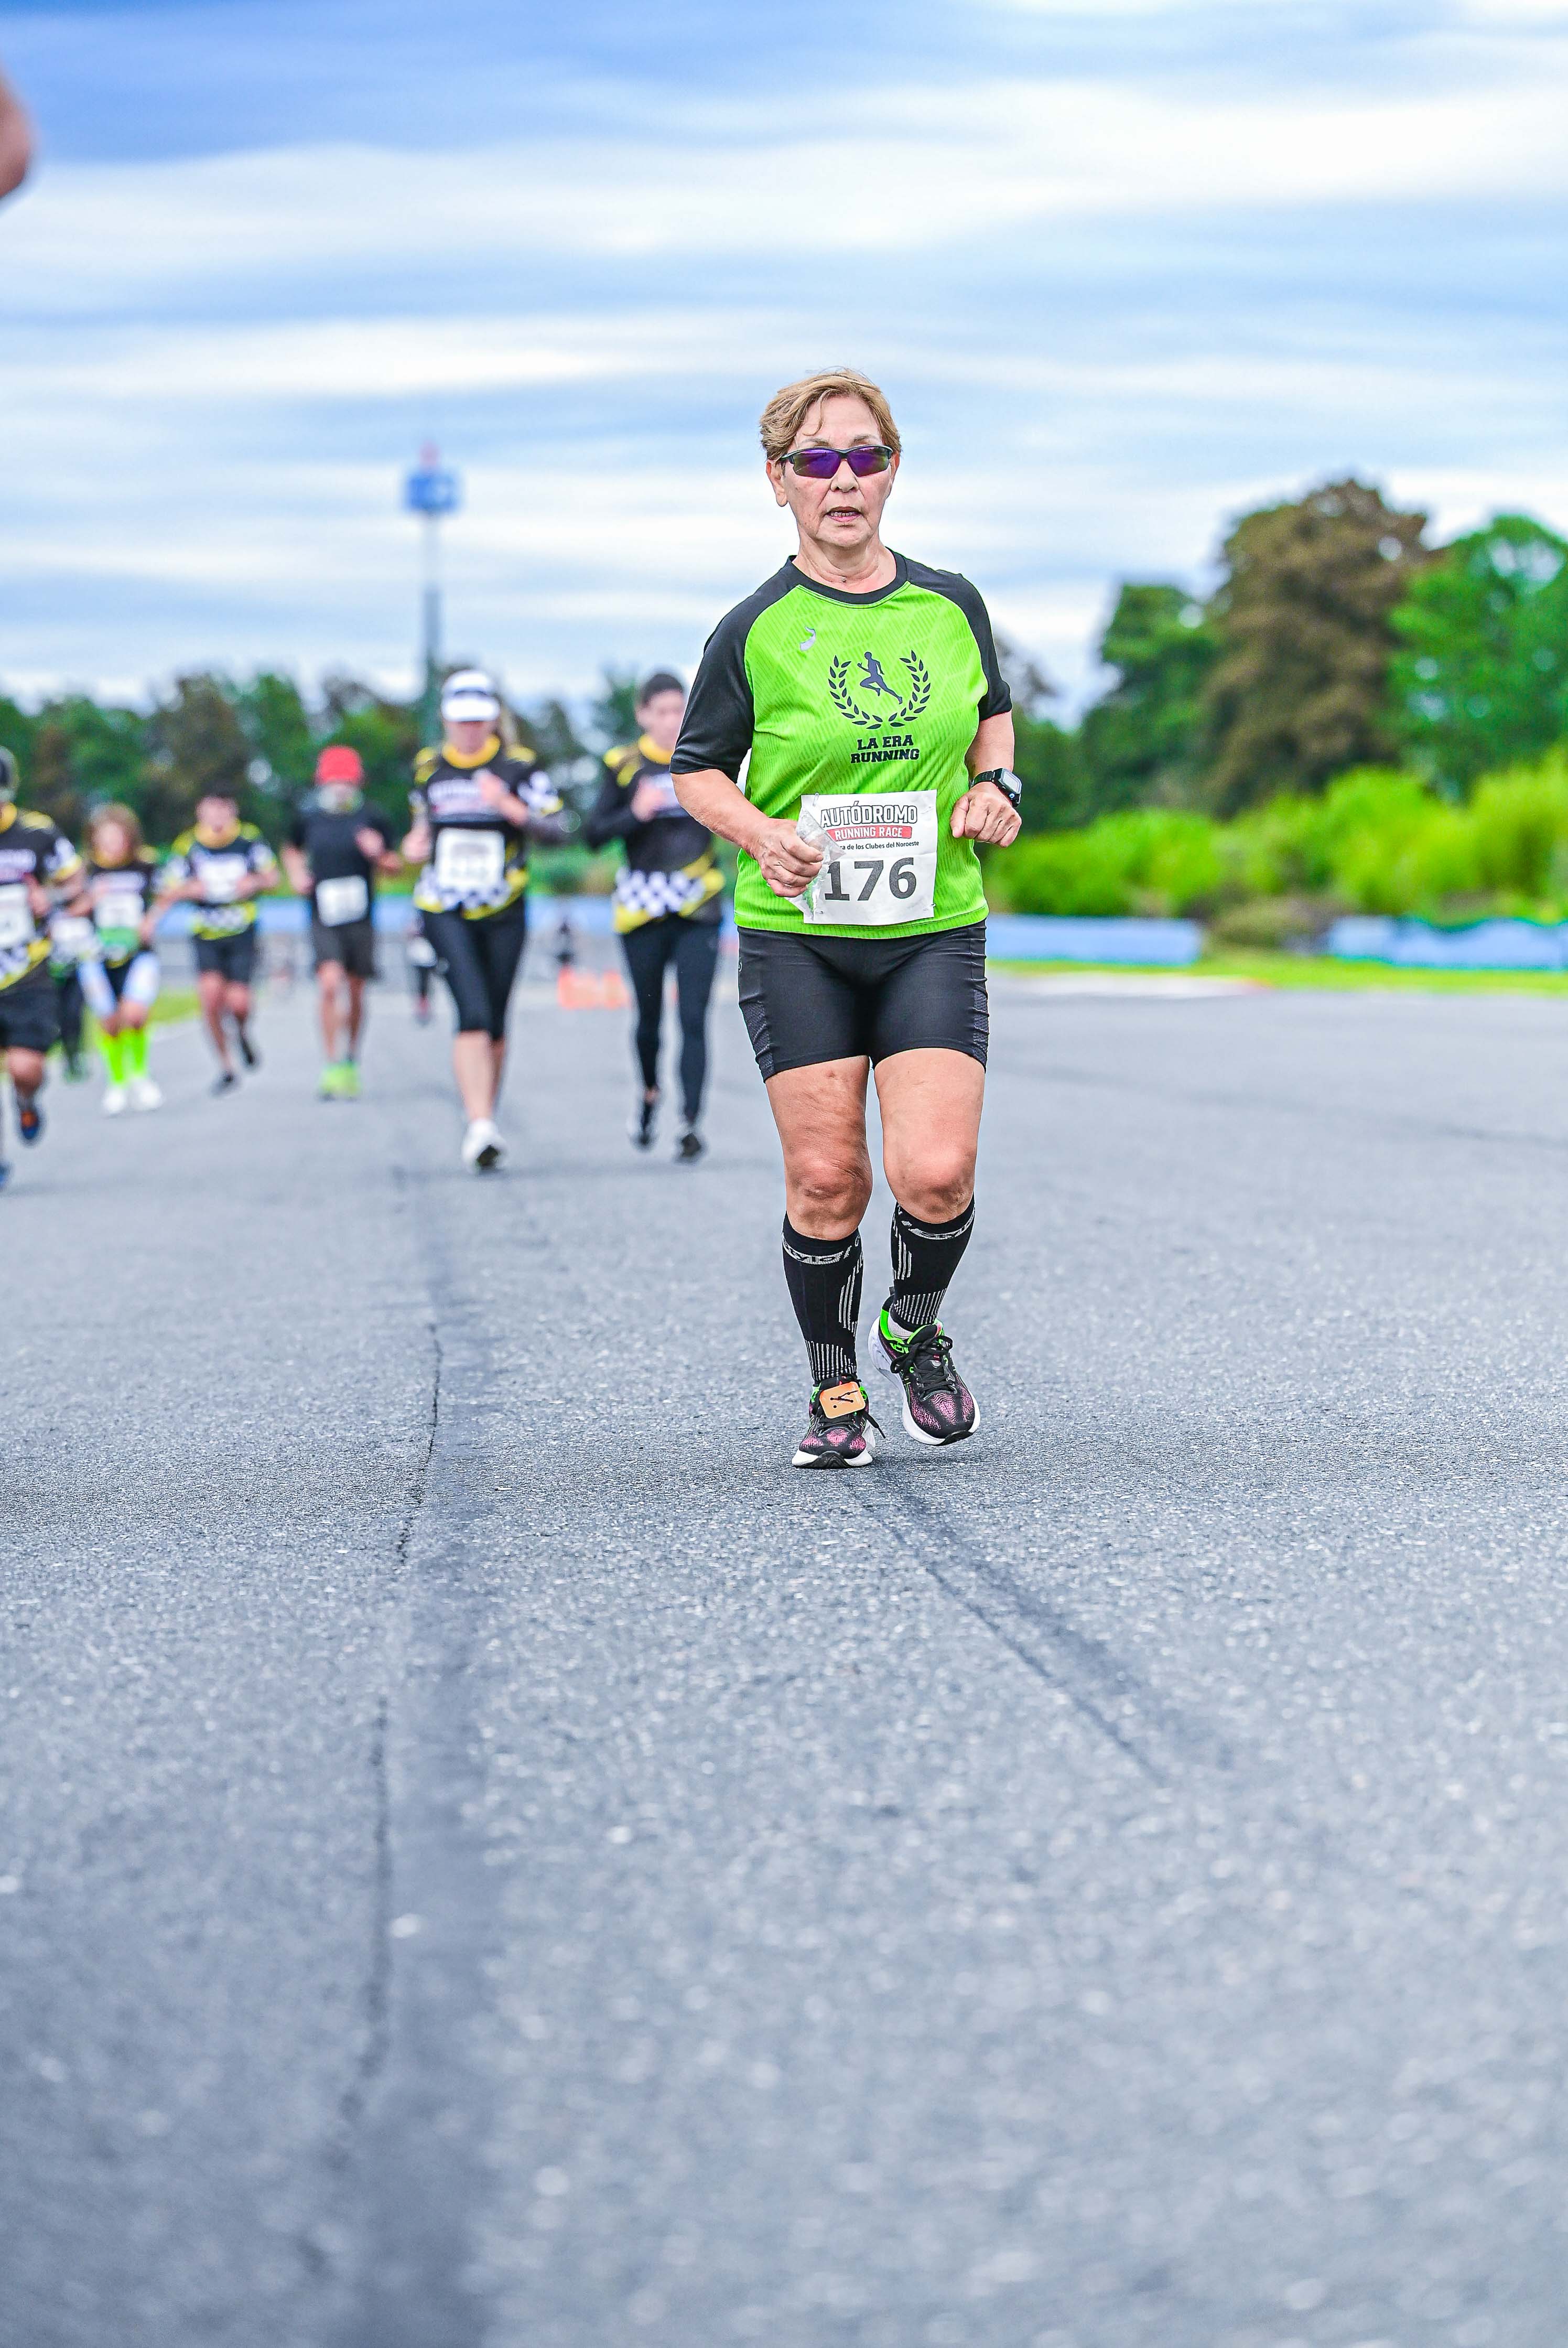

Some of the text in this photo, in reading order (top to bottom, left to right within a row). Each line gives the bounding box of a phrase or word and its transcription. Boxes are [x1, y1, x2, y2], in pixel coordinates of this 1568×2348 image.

[857, 735, 913, 750] LA ERA
[850, 748, 920, 763] RUNNING
[820, 801, 917, 827] AUTÓDROMO
[835, 827, 903, 841] RUNNING RACE
[825, 857, 917, 901] 176
